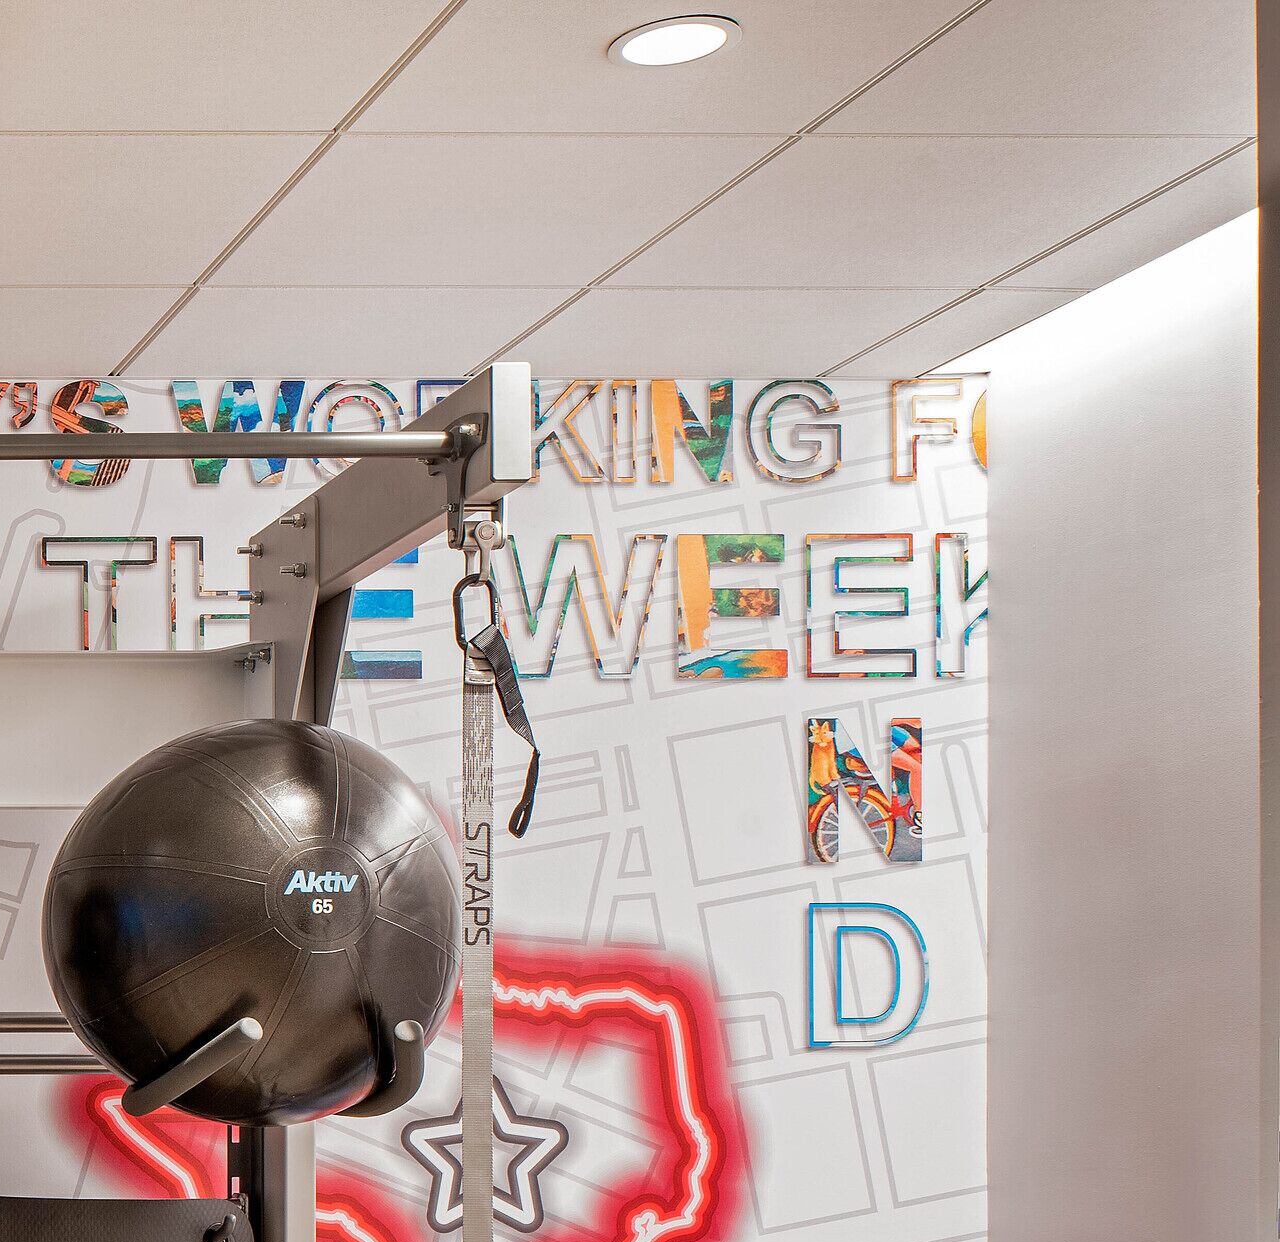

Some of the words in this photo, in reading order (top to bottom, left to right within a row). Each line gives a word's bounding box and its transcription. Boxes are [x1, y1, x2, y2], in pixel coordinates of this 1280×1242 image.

[172, 377, 842, 484] WOKING
[807, 717, 922, 863] N
[283, 869, 359, 895] Aktiv
[312, 898, 334, 914] 65
[808, 902, 930, 1048] D
